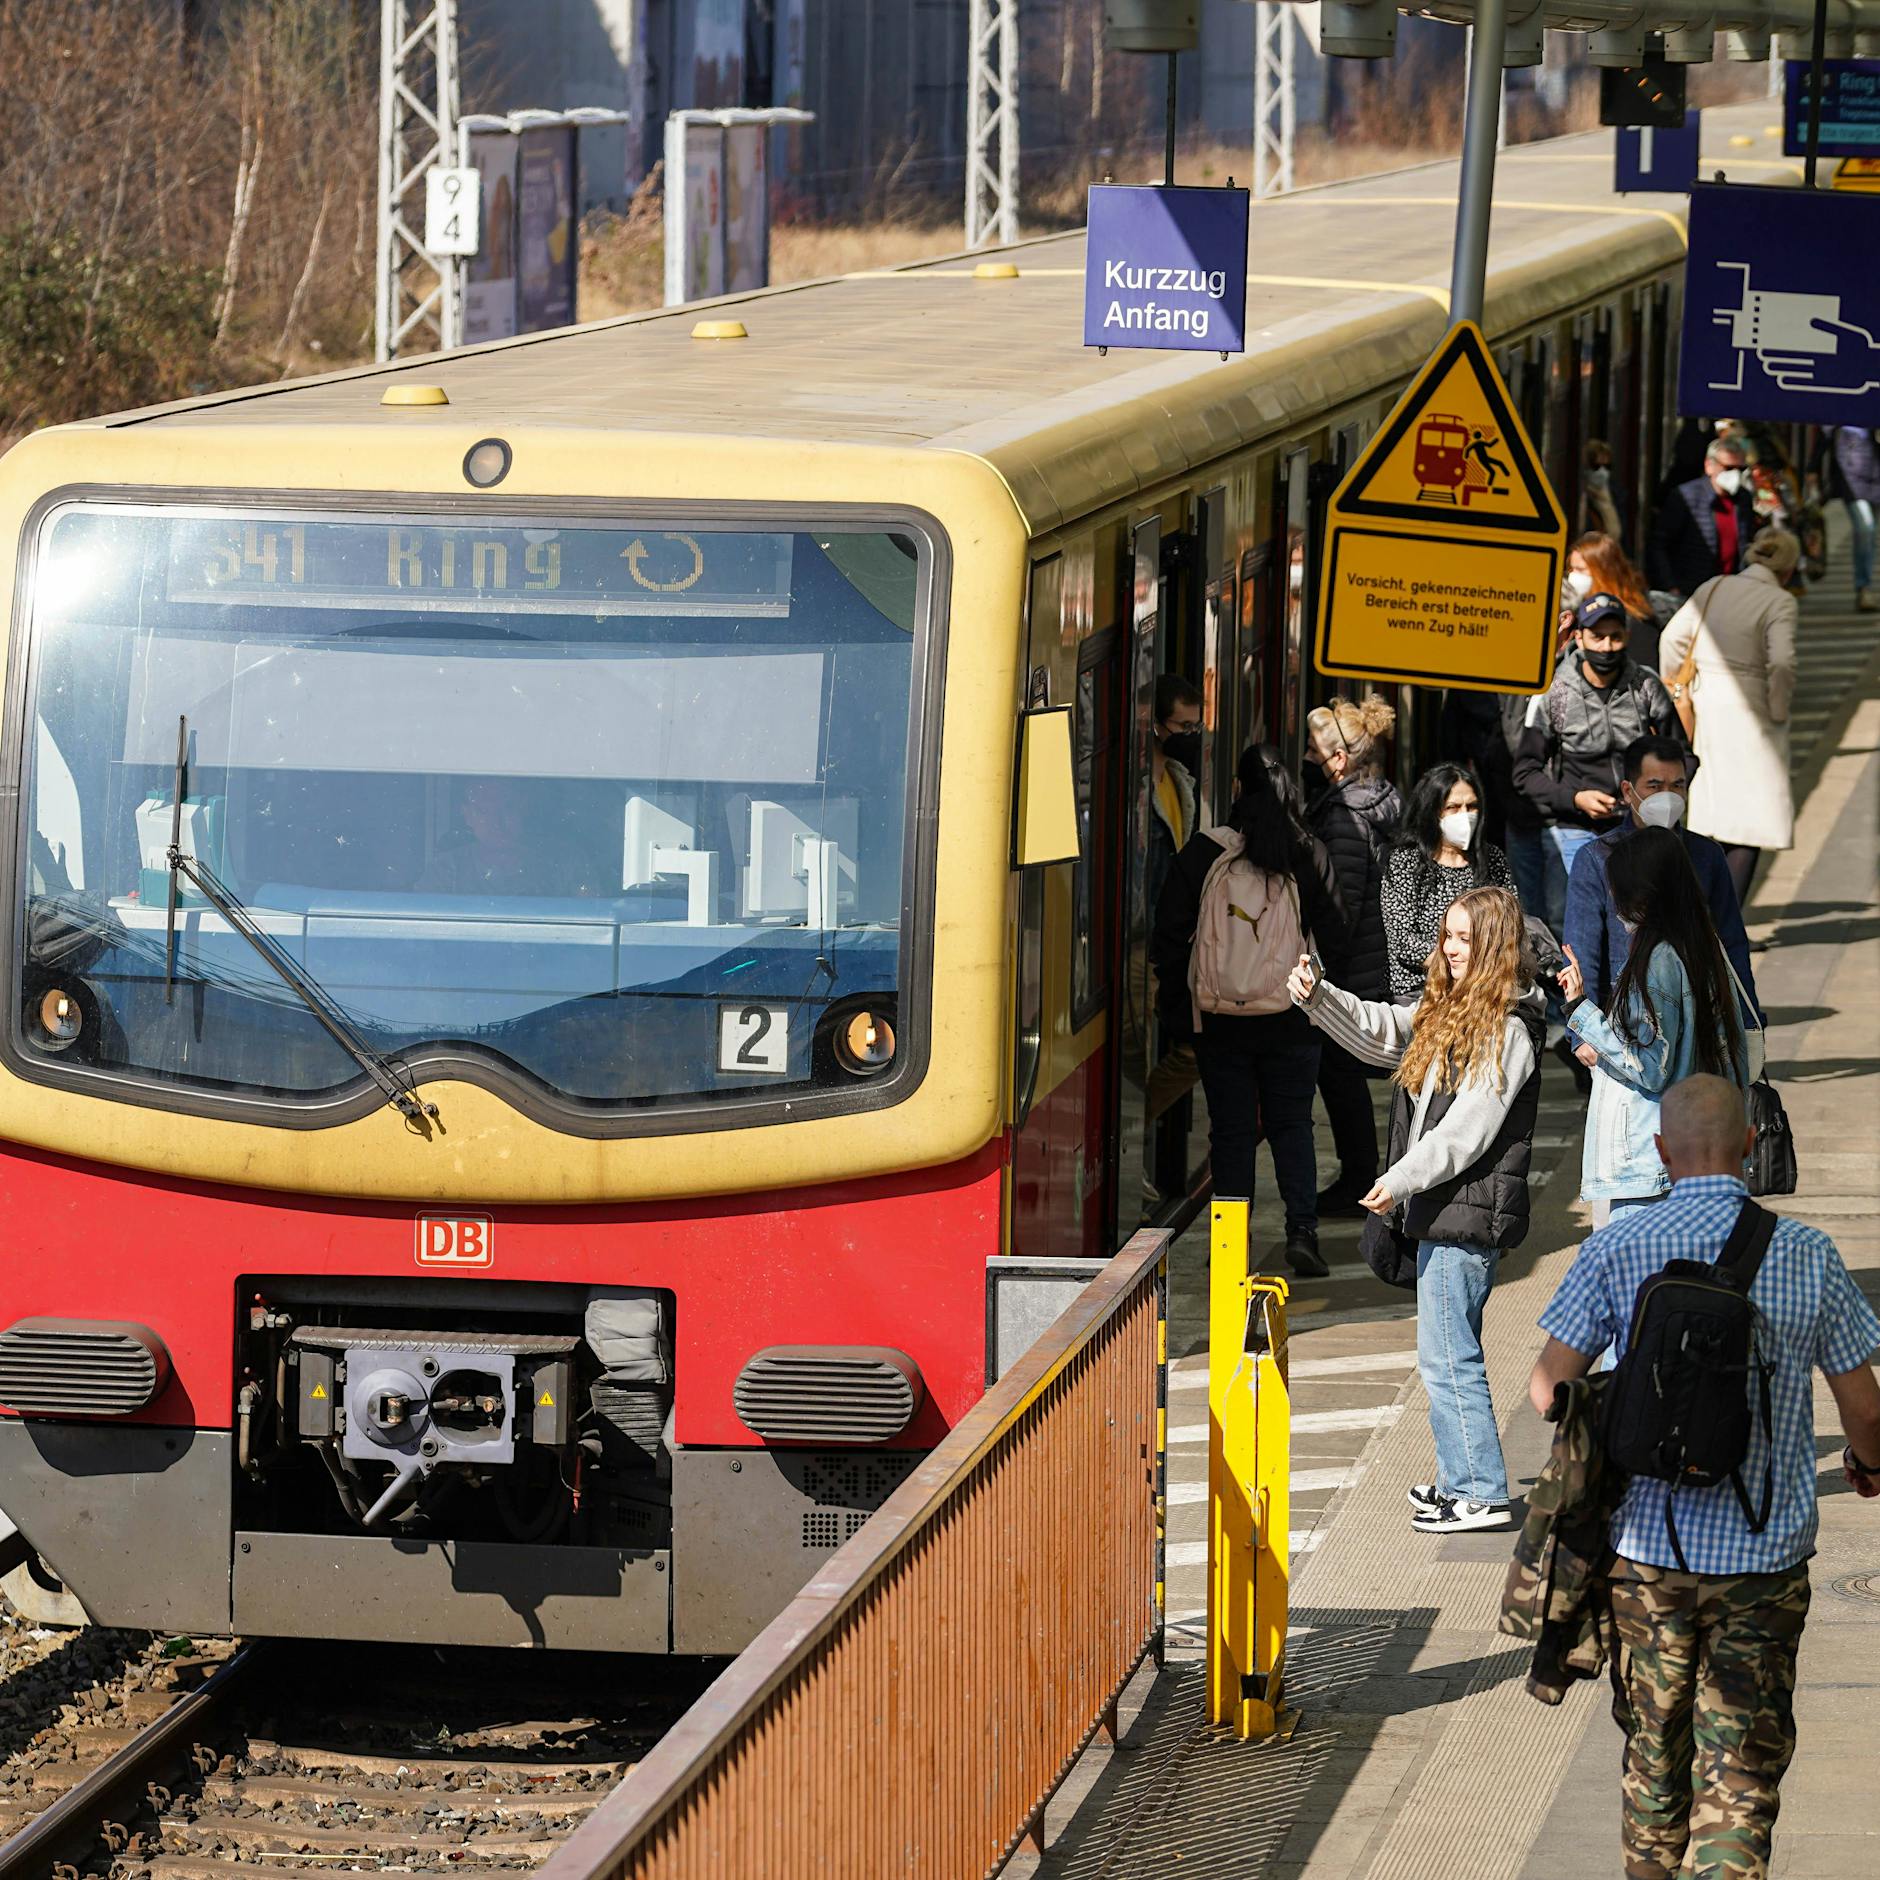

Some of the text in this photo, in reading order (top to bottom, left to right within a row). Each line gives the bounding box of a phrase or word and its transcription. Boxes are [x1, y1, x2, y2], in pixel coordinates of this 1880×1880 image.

[443, 175, 461, 204] 9
[443, 214, 460, 241] 4
[1105, 260, 1226, 299] Kurzzug
[1103, 300, 1209, 338] Anfang
[207, 521, 305, 584] S41
[1365, 593, 1418, 611] Bereich
[1422, 602, 1450, 614] erst
[1411, 581, 1536, 603] gekennzeichneten
[1387, 617, 1488, 637] wenn Zug hält!
[736, 1006, 771, 1065] 2
[426, 1220, 484, 1258] DB
